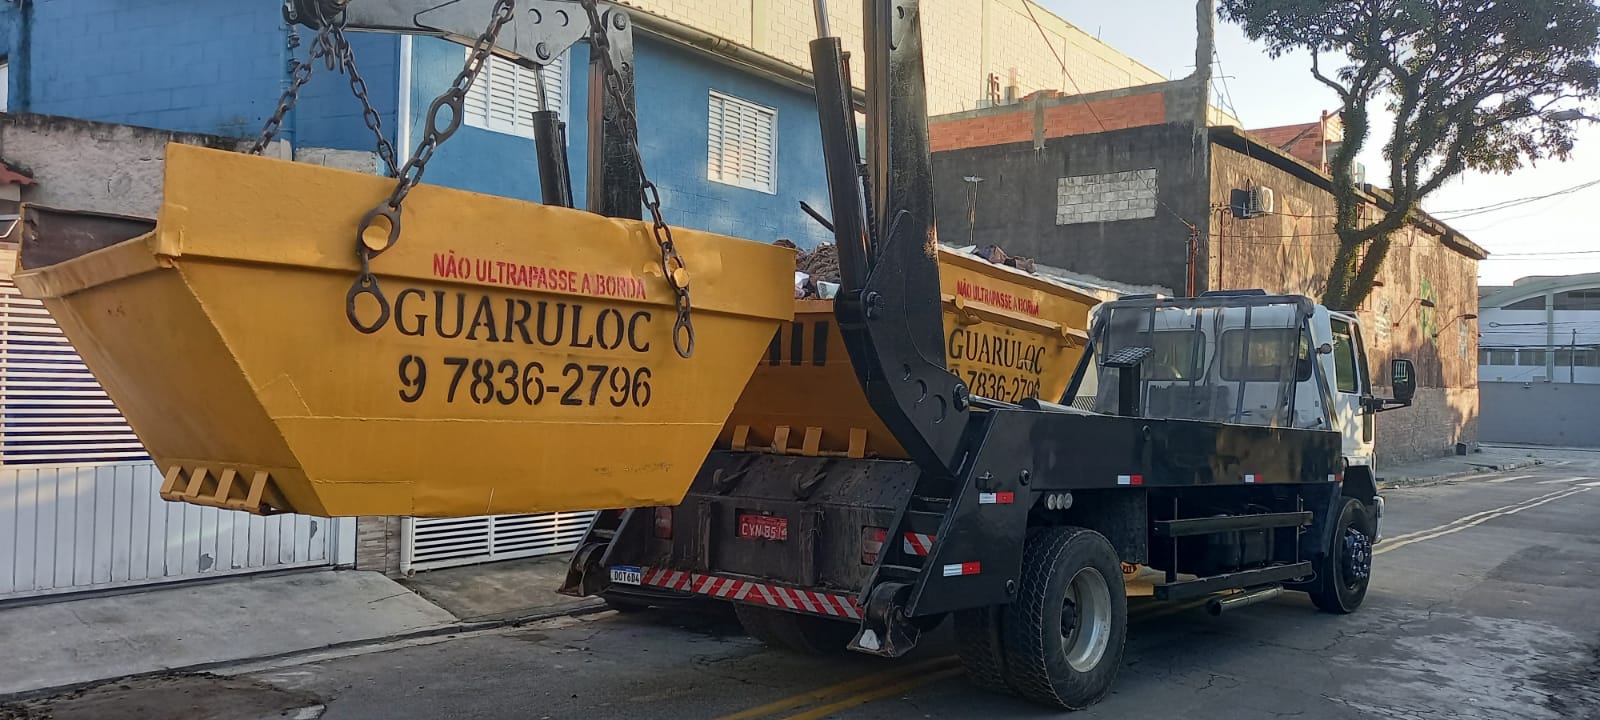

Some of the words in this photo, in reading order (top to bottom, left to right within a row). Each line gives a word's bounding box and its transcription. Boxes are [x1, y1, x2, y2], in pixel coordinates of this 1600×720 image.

[433, 250, 471, 280] NÃO
[475, 258, 577, 292] ULTRAPASSE
[581, 276, 592, 295] A
[595, 274, 647, 300] BORDA
[973, 284, 1012, 310] ULTRAPASSE
[394, 288, 652, 353] GUARULOC
[949, 328, 1046, 375] GUARULOC
[398, 355, 427, 403] 9
[443, 357, 652, 408] 7836-2796
[967, 370, 1041, 405] 7836-2796
